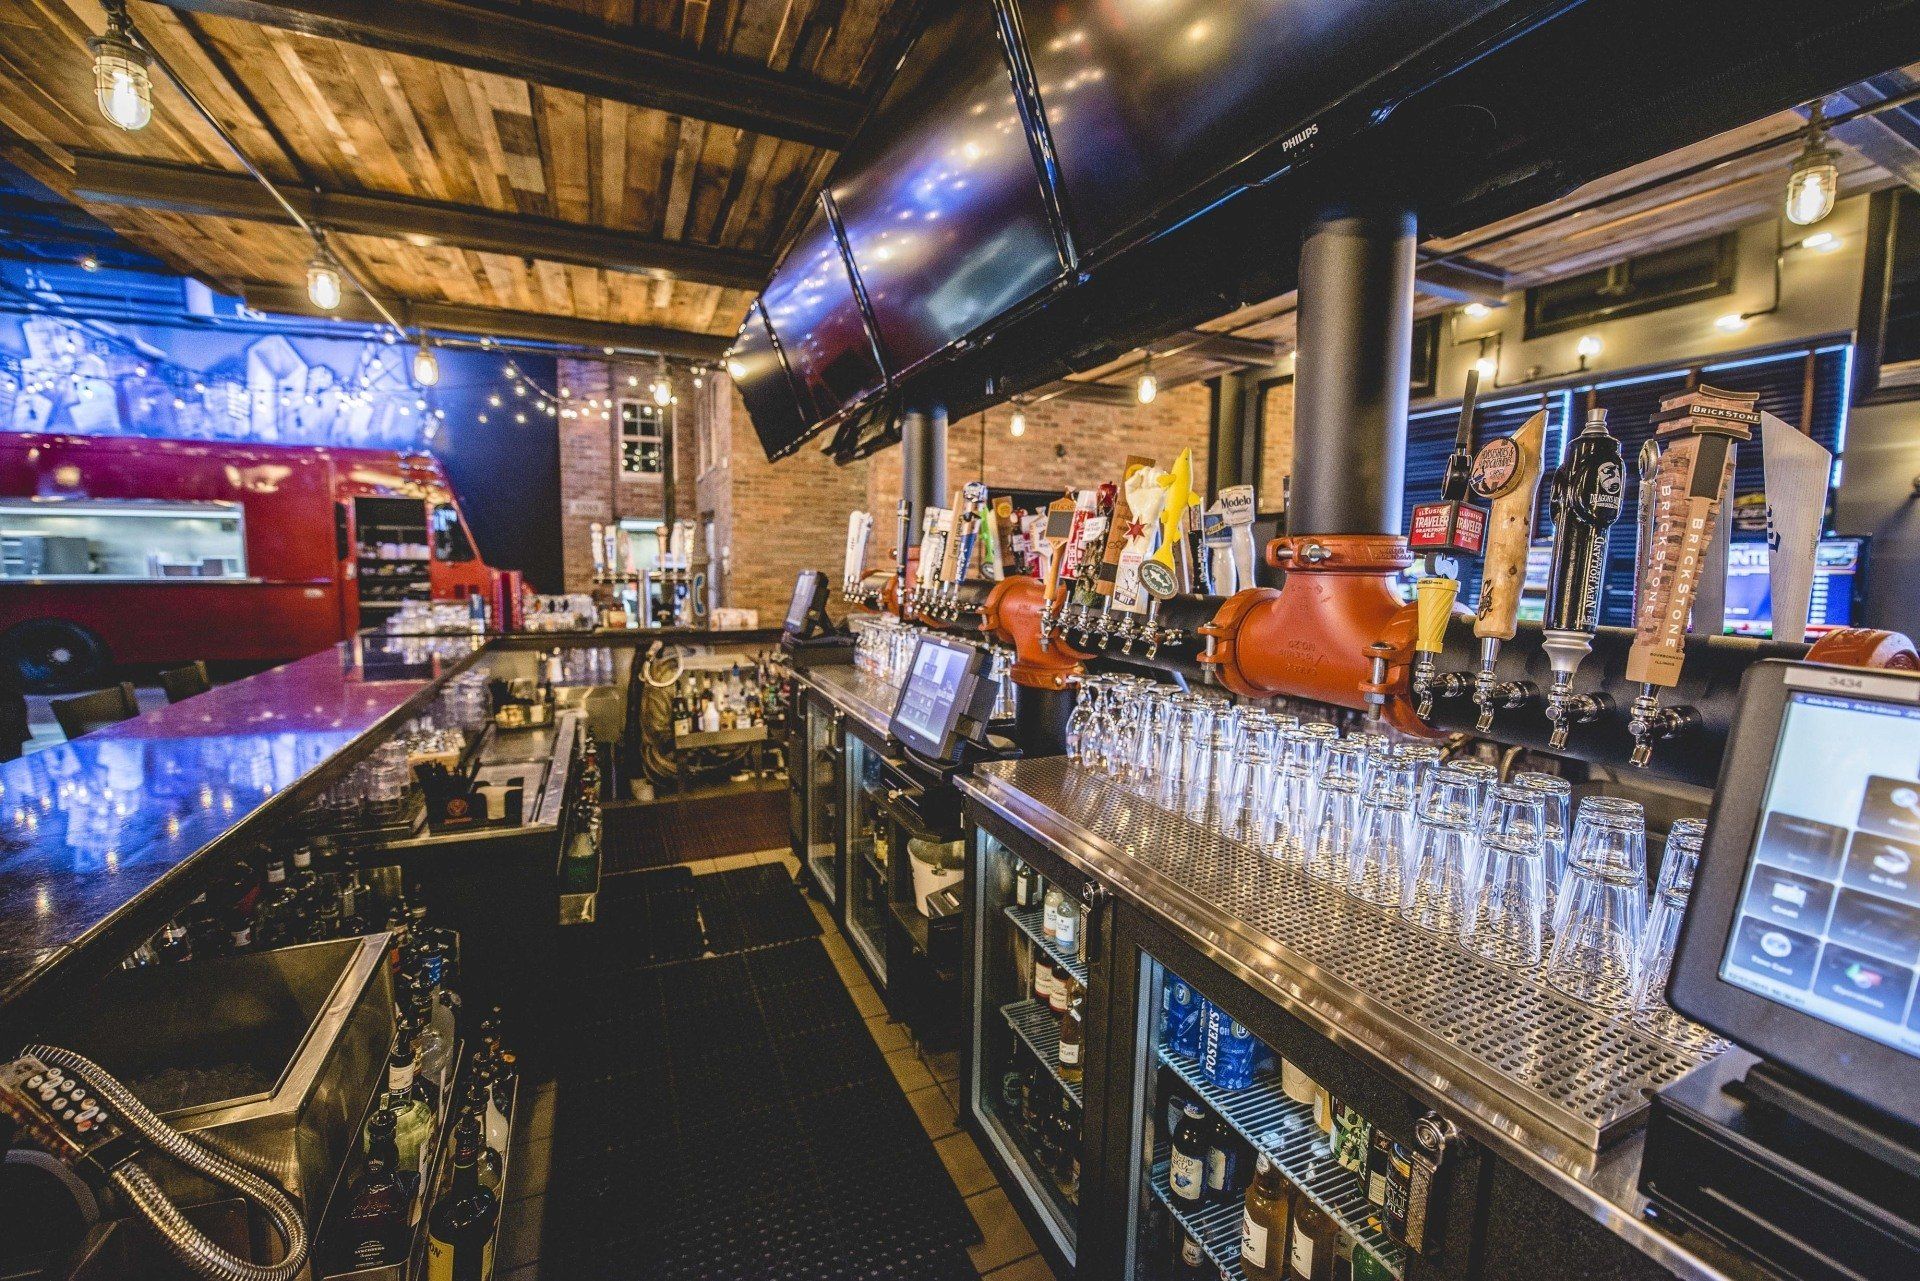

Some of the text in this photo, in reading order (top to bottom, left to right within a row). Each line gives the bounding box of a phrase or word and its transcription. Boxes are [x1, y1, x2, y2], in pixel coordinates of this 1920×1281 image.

[1281, 123, 1319, 152] PHILIPS
[1692, 405, 1760, 422] BRICKSTONE
[1221, 494, 1252, 510] Modelo
[1415, 515, 1450, 529] TRAVELER
[1456, 516, 1483, 535] TRAVELER
[1644, 484, 1672, 614] BRICKSTONE
[1585, 536, 1605, 608] NEW HOLLAND
[1665, 518, 1704, 648] BRICKSTONE
[1829, 677, 1863, 689] 3434
[1205, 1008, 1220, 1075] FOSTER'S
